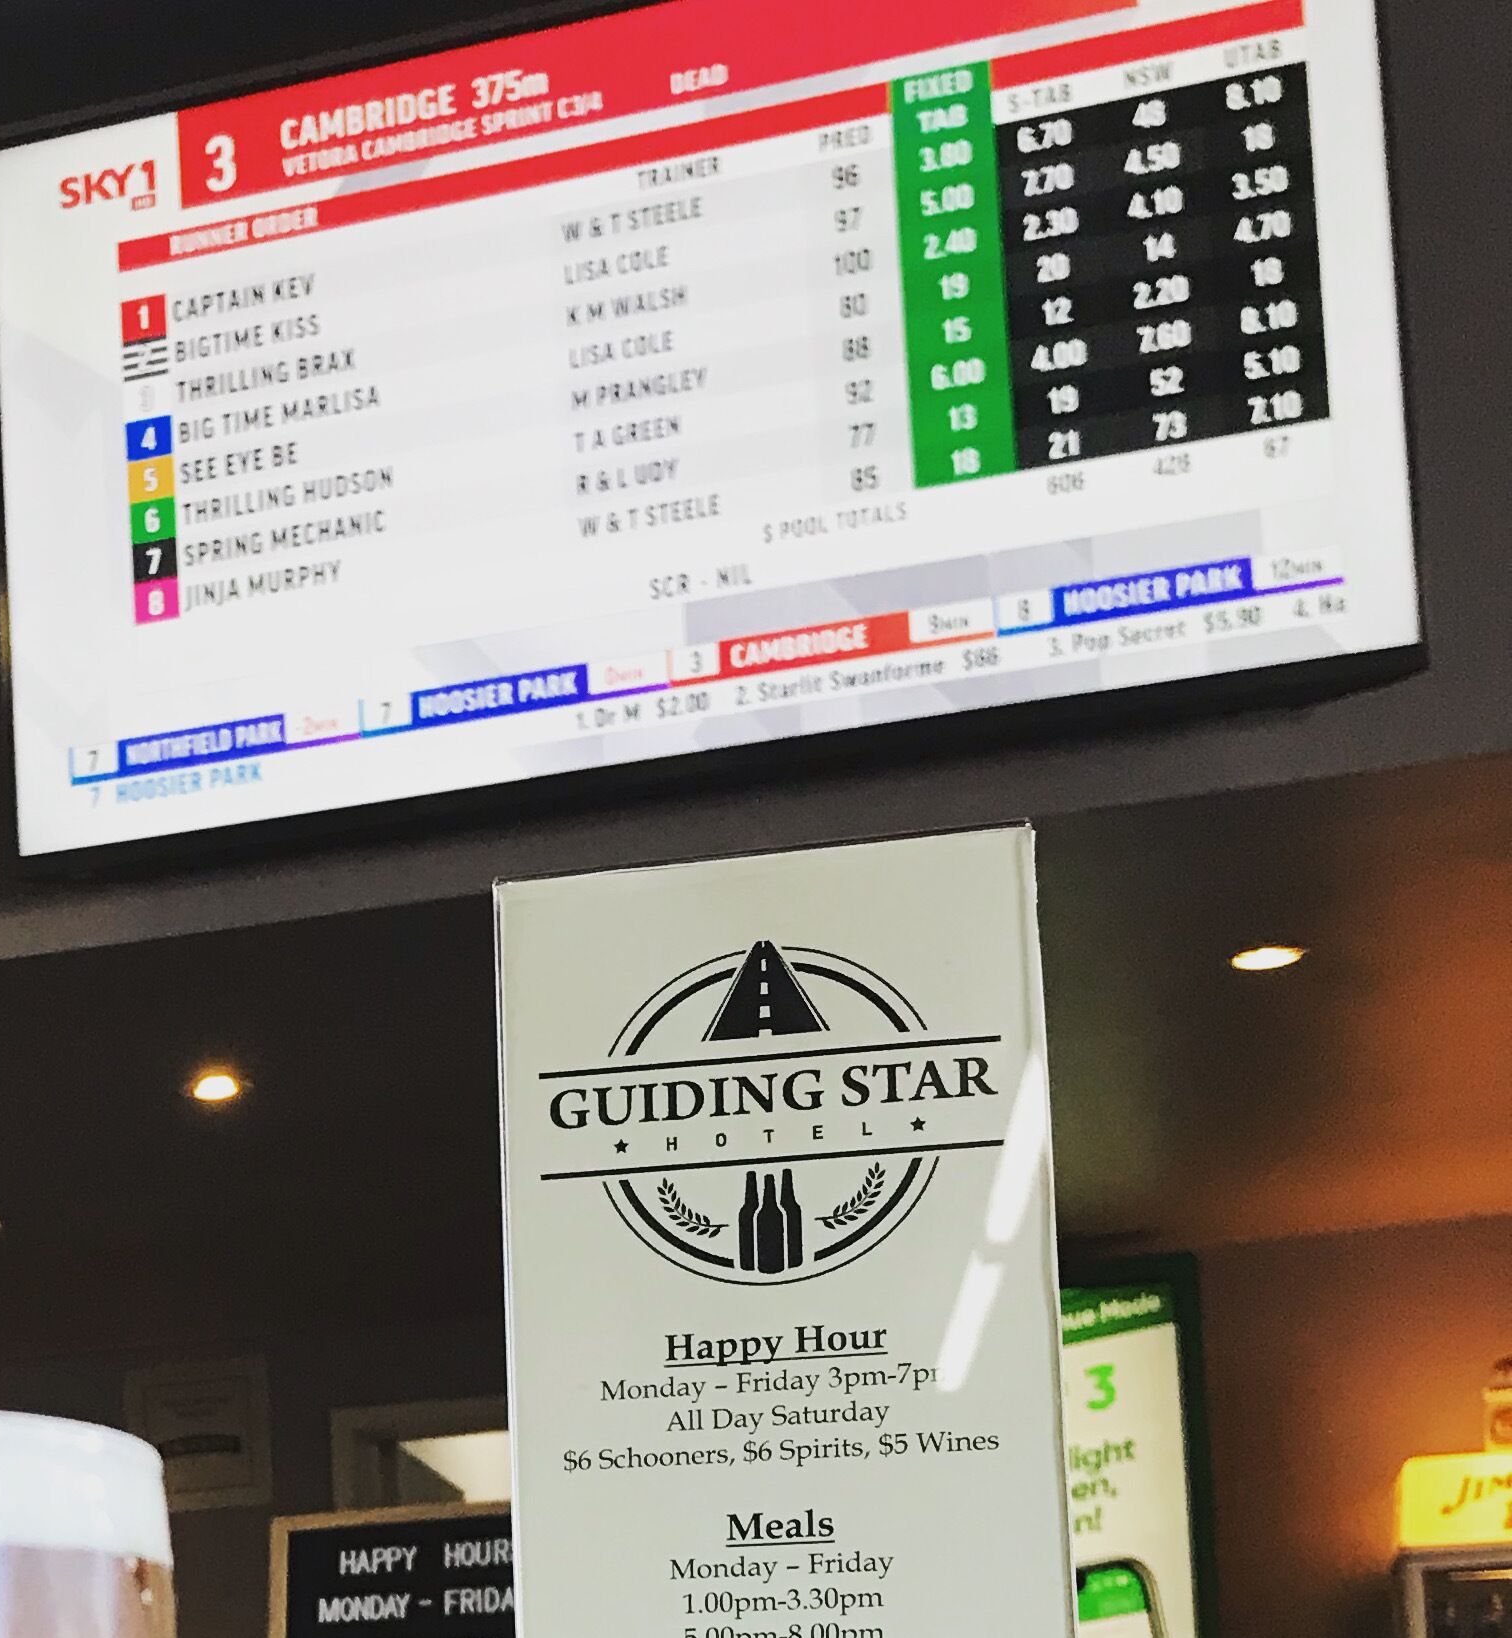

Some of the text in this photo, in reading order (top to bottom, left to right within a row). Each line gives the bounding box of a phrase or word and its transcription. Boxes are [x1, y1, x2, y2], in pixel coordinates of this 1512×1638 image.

[279, 69, 549, 151] CAMBRIDGE 375m
[204, 134, 238, 193] 3
[137, 273, 314, 331] 1 CAPTAIN KEV
[175, 315, 321, 363] BIGTIME KISS
[176, 359, 289, 404] THRILLING
[296, 349, 357, 378] BRAX
[140, 386, 380, 451] 4 BIG TIME MARLISA
[144, 442, 298, 493] 5 SEE EYE BE
[144, 467, 395, 533] 6 THRILLING HUDSON
[146, 510, 387, 575] 7 SPRING MECHANIC
[147, 561, 341, 616] 8 JINJA MURPHY
[1063, 565, 1242, 616] HOOSIER PARK
[730, 624, 868, 669] CAMBRIDGE
[419, 670, 578, 719] HOOSIER PARK
[549, 1056, 998, 1130] GUIDING STAR
[666, 1121, 873, 1153] HOTEL
[664, 1324, 888, 1366] Happy Hour
[601, 1377, 706, 1403] Monday
[736, 1368, 820, 1396] Friday
[1085, 1364, 1116, 1410] 3
[666, 1402, 890, 1433] All Day Saturday
[563, 1431, 1000, 1472] $6 Schooners, $6 Spirits, $5 Wines
[727, 1509, 835, 1541] Meals
[339, 1538, 514, 1575] HAPPY HOUR
[670, 1552, 894, 1582] Monday Friday
[318, 1587, 514, 1624] MONDAY FRIDA
[683, 1588, 884, 1617] 1.00pm-3.30pm
